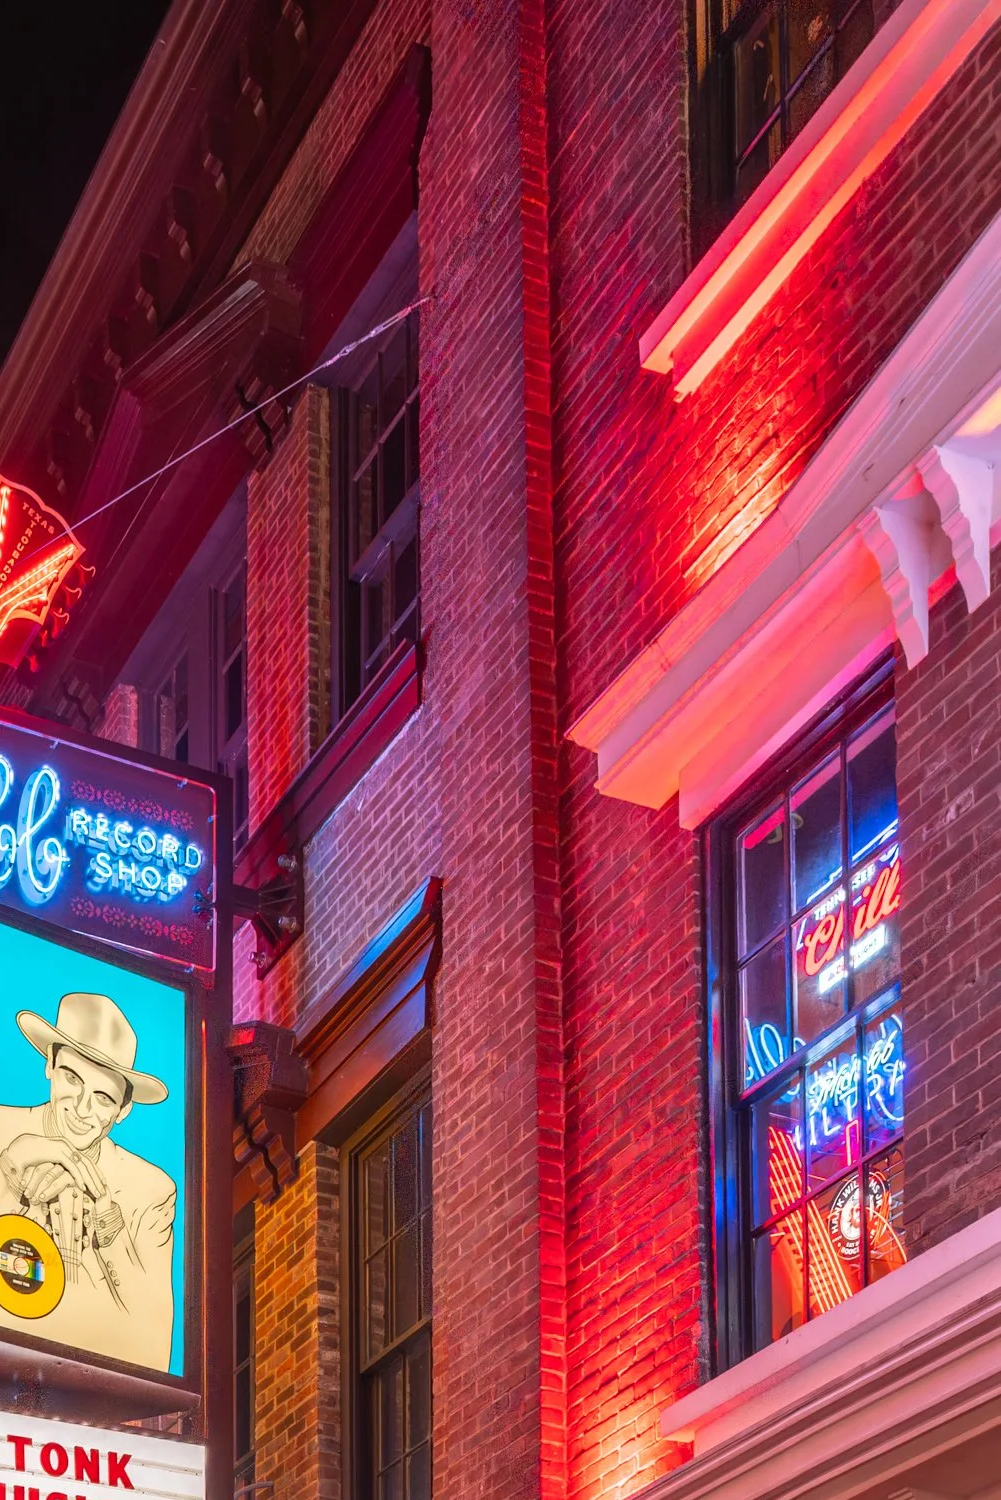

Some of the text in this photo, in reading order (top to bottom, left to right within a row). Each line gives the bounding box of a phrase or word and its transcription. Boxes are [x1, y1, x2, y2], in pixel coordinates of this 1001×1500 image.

[22, 502, 55, 535] TEXAS
[66, 808, 202, 874] RECORD
[86, 851, 188, 900] SHOP
[814, 864, 875, 920] TENNSEE
[7, 1434, 135, 1490] TONK
